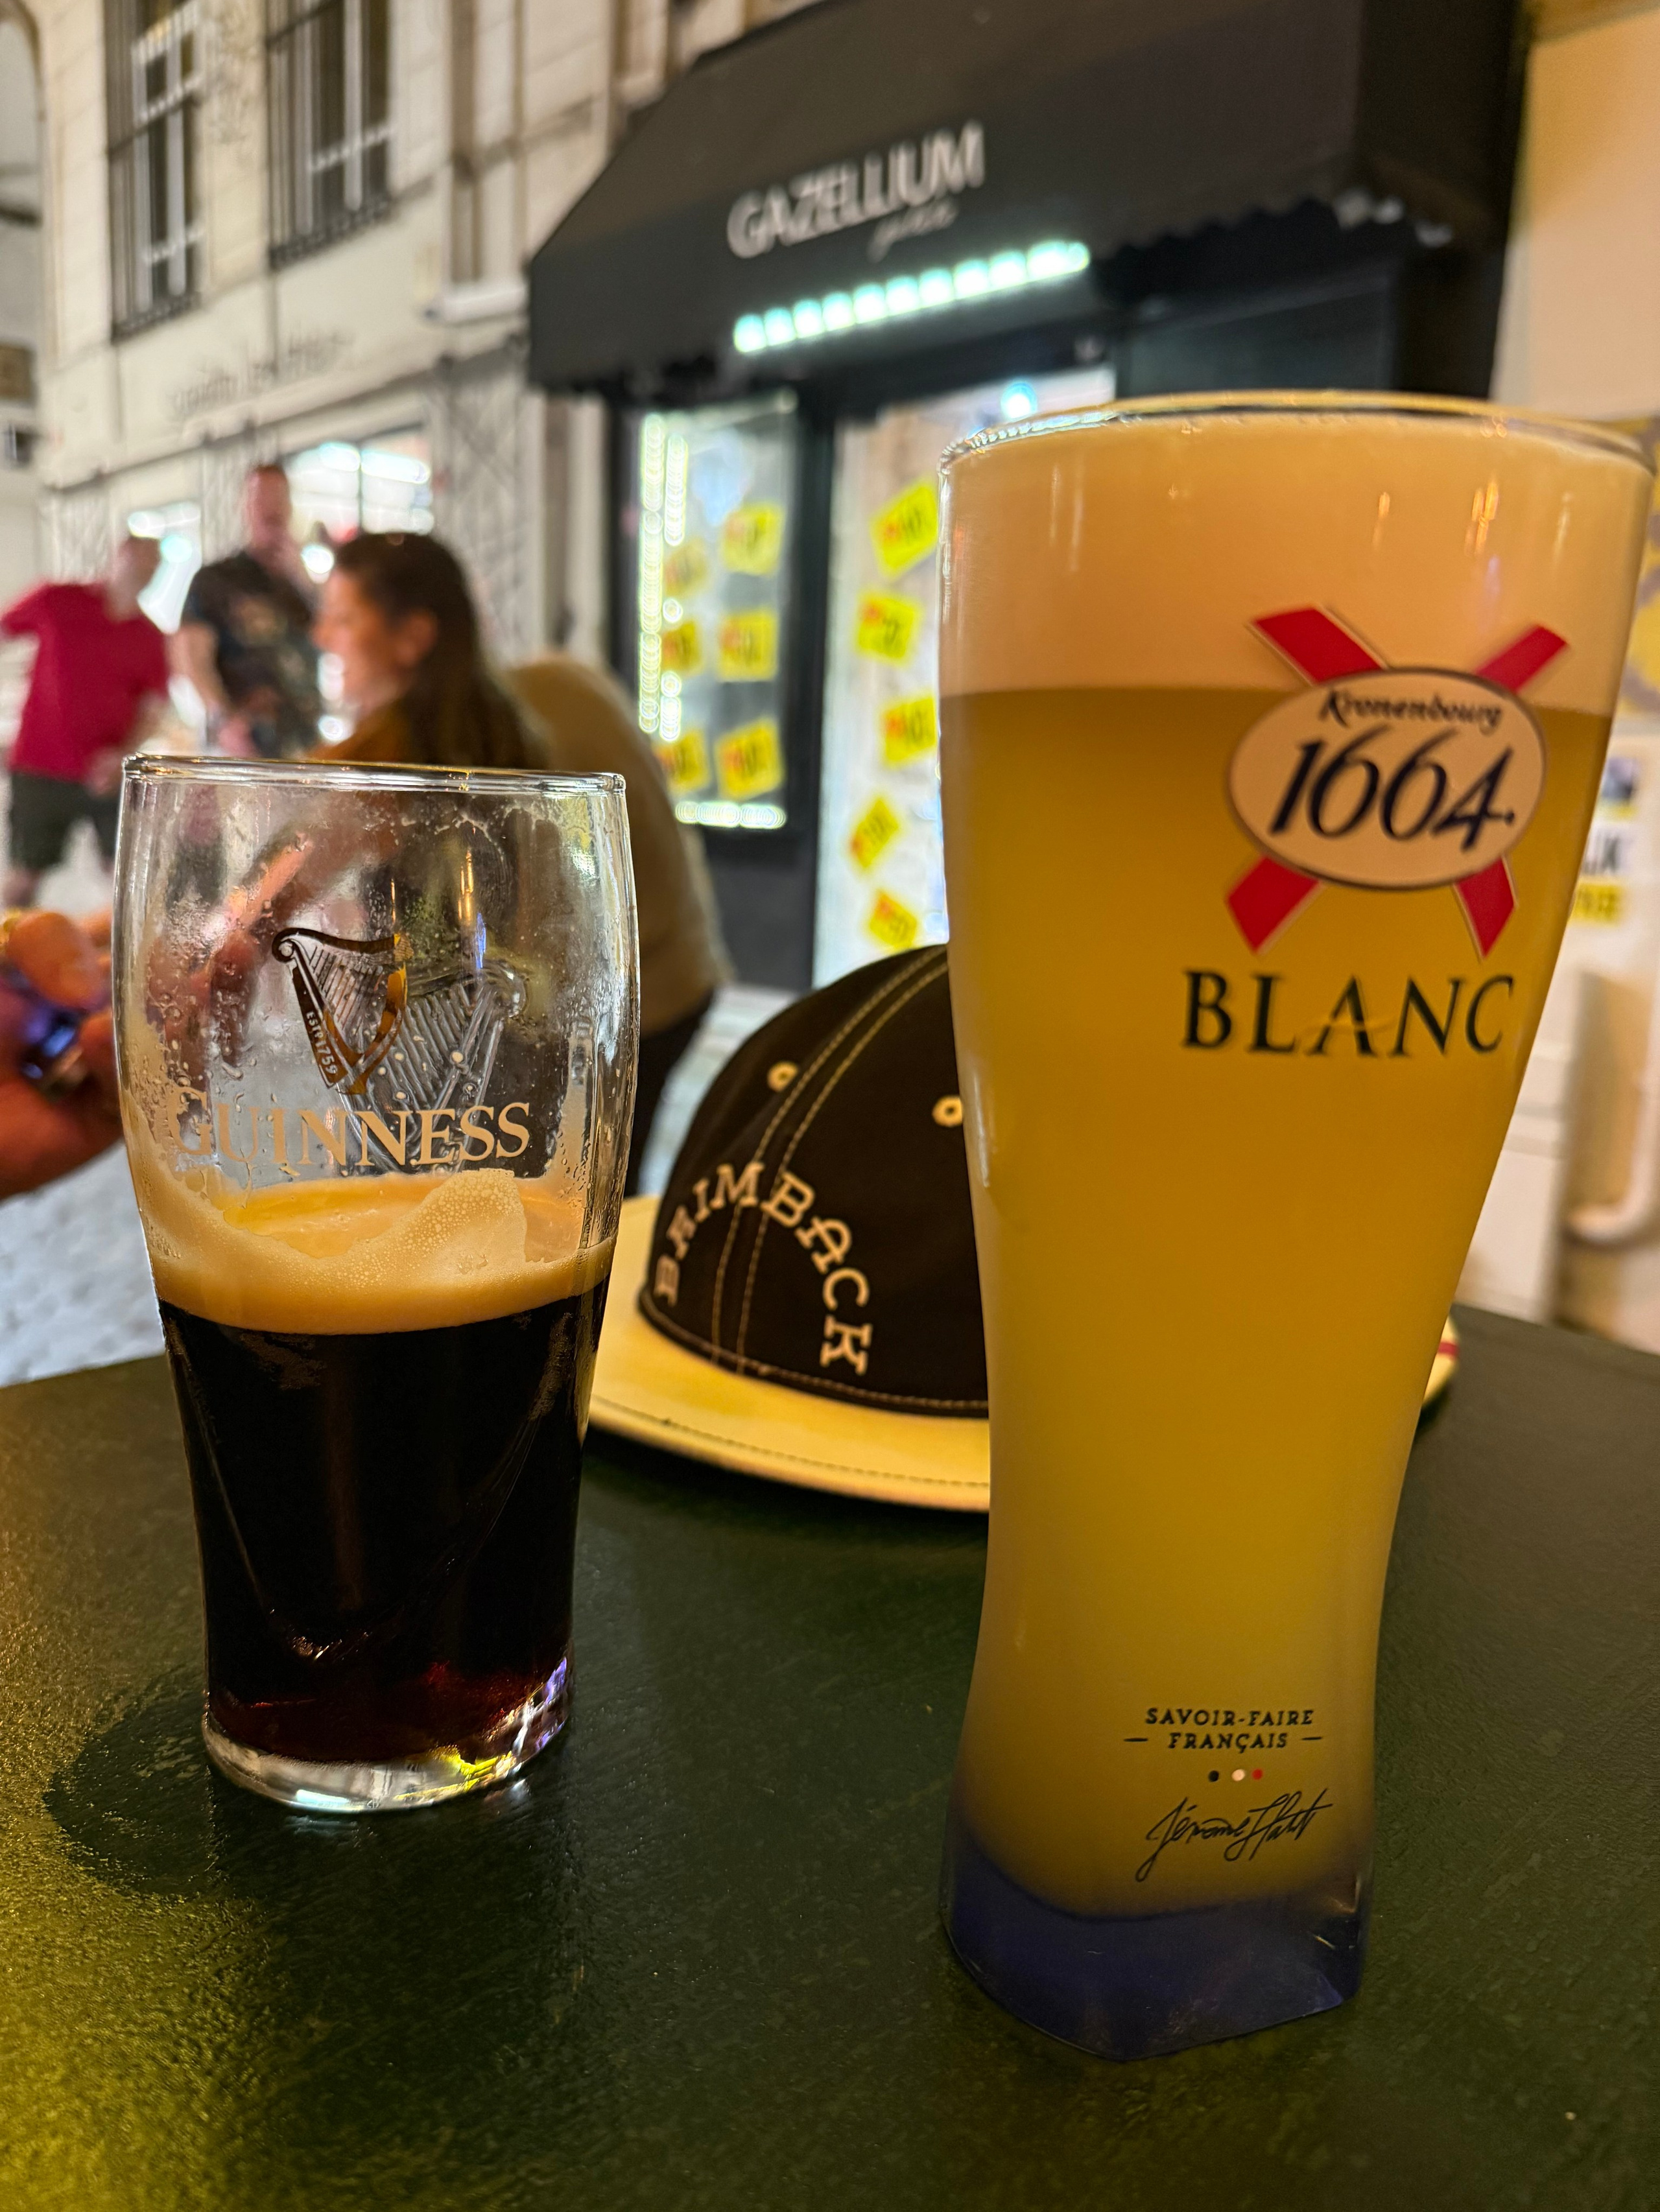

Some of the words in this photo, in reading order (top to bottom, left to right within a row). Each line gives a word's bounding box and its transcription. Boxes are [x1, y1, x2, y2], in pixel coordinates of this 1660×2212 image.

[726, 121, 985, 258] GAZELLIUM
[1319, 689, 1501, 736] Kronenbourg
[1269, 725, 1514, 852] 1664
[1181, 969, 1513, 1059] BLANC
[315, 1037, 337, 1074] 1759
[166, 1086, 530, 1167] GUINNESS
[1145, 1708, 1314, 1726] SAVOIR-FAIRE
[1168, 1732, 1288, 1753] FRANÇAIS
